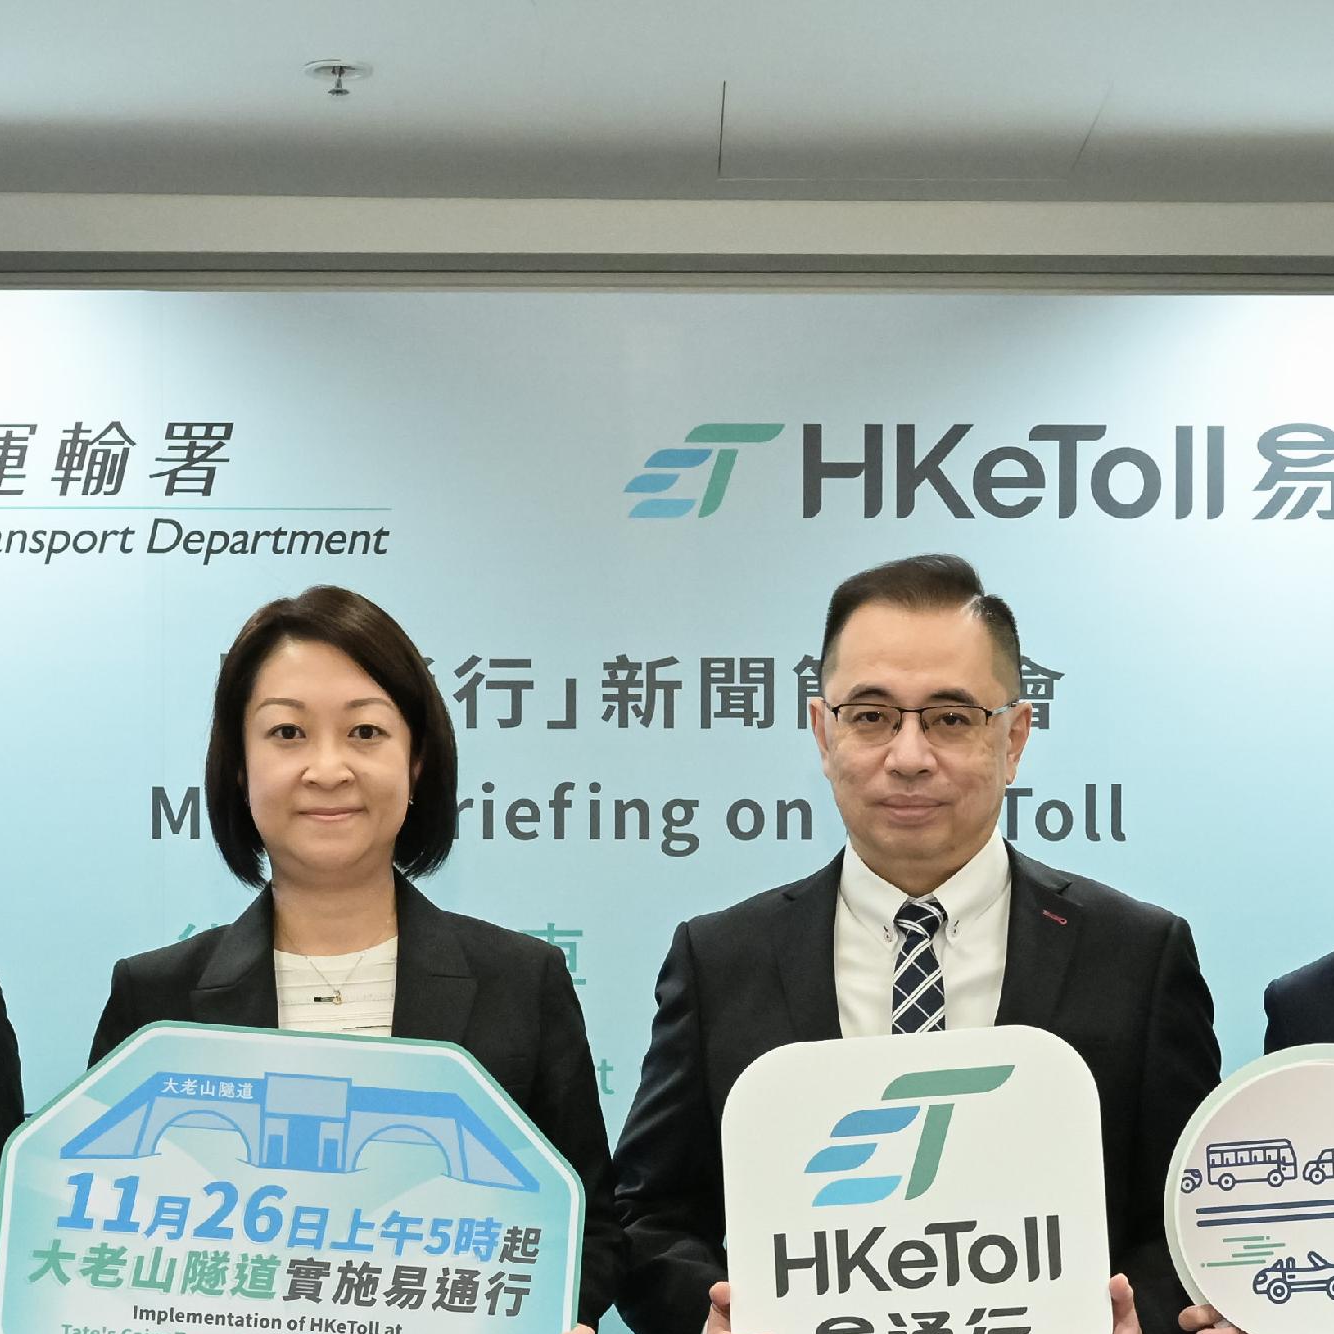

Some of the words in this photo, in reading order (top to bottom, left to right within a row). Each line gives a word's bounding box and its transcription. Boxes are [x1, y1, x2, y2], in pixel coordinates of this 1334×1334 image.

[802, 422, 1225, 520] HKeToll
[147, 518, 390, 565] Department
[454, 781, 700, 857] riefing
[726, 797, 813, 841] on
[1005, 784, 1125, 841] Toll
[161, 1076, 254, 1101] 大老山隧道
[56, 1171, 543, 1266] 11月26日上午5時起
[773, 1214, 1062, 1298] HKeToll
[27, 1238, 534, 1319] 大老山隧道實施易通行
[132, 1305, 282, 1334] Implementation
[286, 1313, 308, 1333] of
